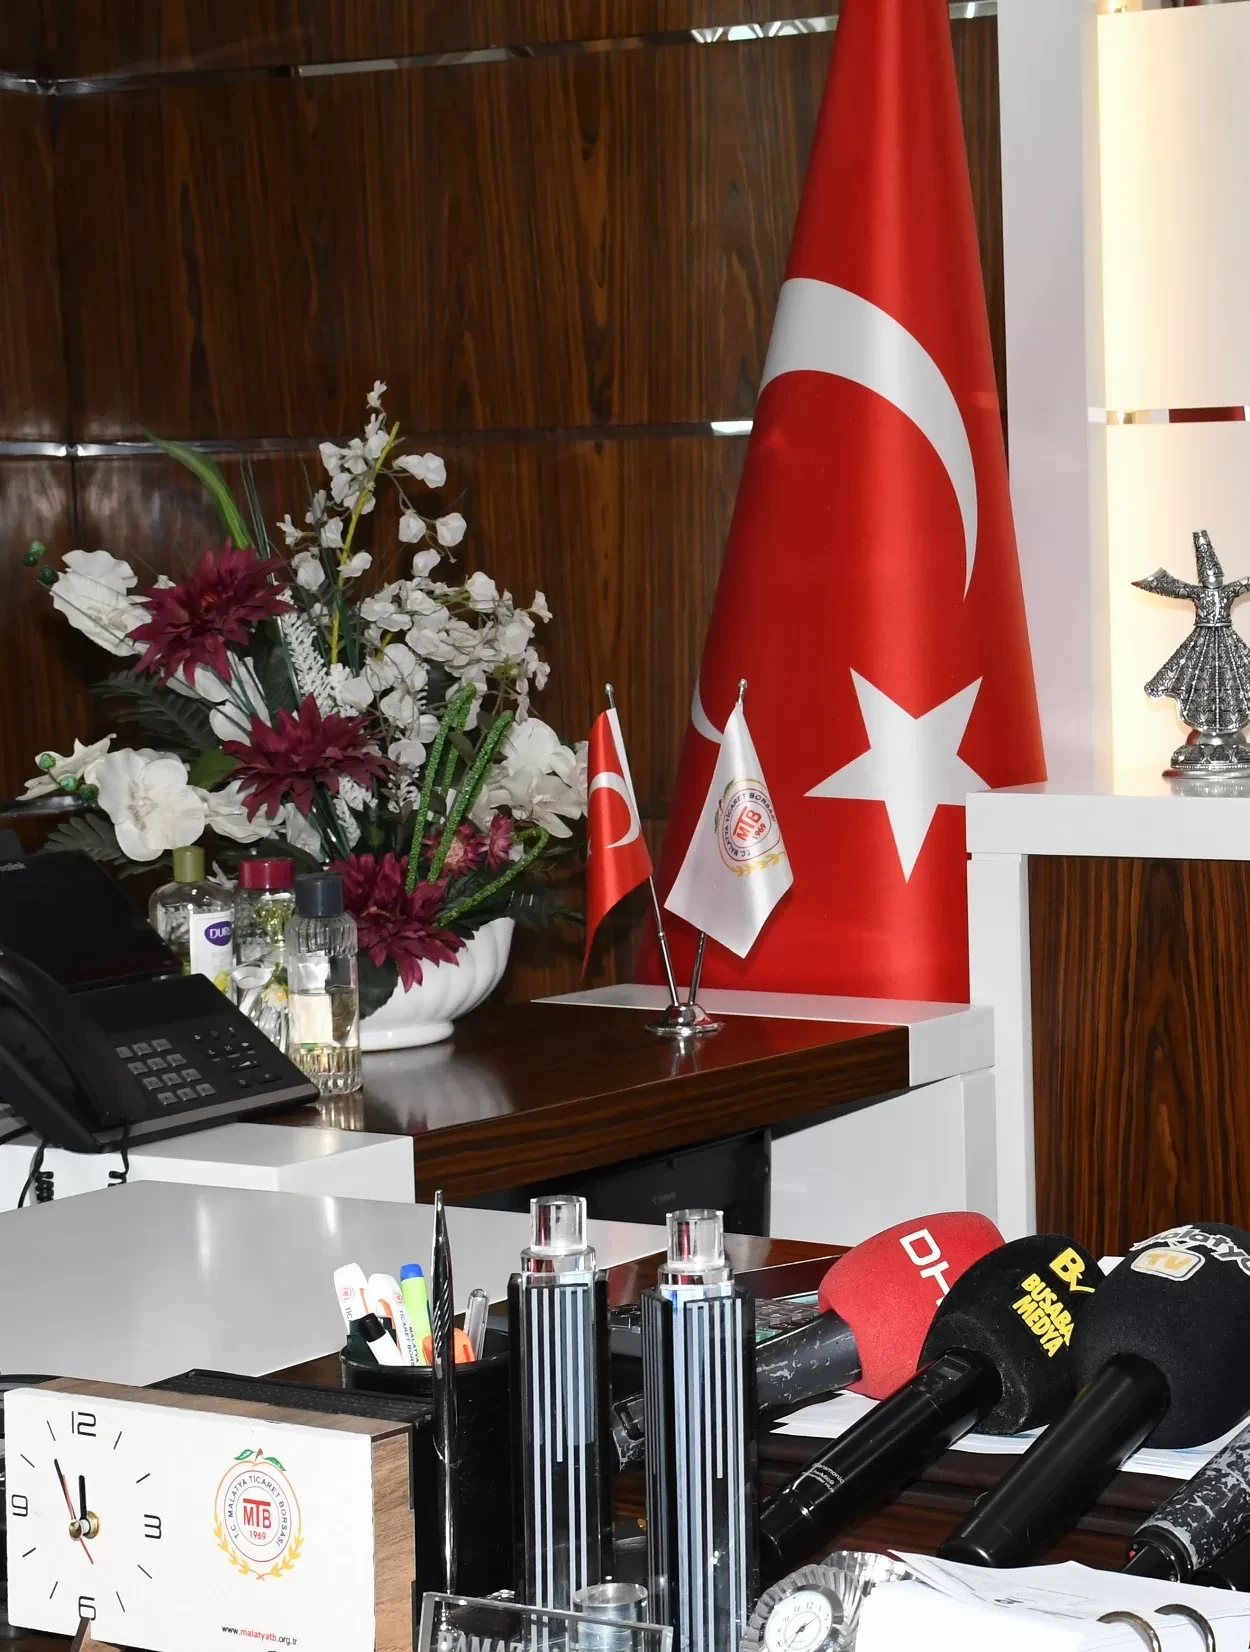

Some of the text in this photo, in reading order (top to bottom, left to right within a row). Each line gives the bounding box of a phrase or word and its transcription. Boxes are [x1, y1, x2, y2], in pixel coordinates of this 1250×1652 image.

[733, 806, 762, 841] MTB
[752, 823, 767, 840] 1969
[899, 1228, 950, 1307] DH
[1020, 1273, 1075, 1347] BUSABA
[1012, 1294, 1065, 1358] MEDYA
[72, 1411, 97, 1437] 12
[11, 1494, 28, 1517] 9
[228, 1478, 248, 1518] MALATYA
[249, 1473, 281, 1498] TİCARET
[276, 1500, 288, 1547] BORSASI
[243, 1498, 272, 1529] MTB
[144, 1514, 162, 1540] 3
[249, 1529, 267, 1541] 1969
[78, 1595, 97, 1621] 6
[221, 1626, 298, 1647] www.malatyatb.org.tr
